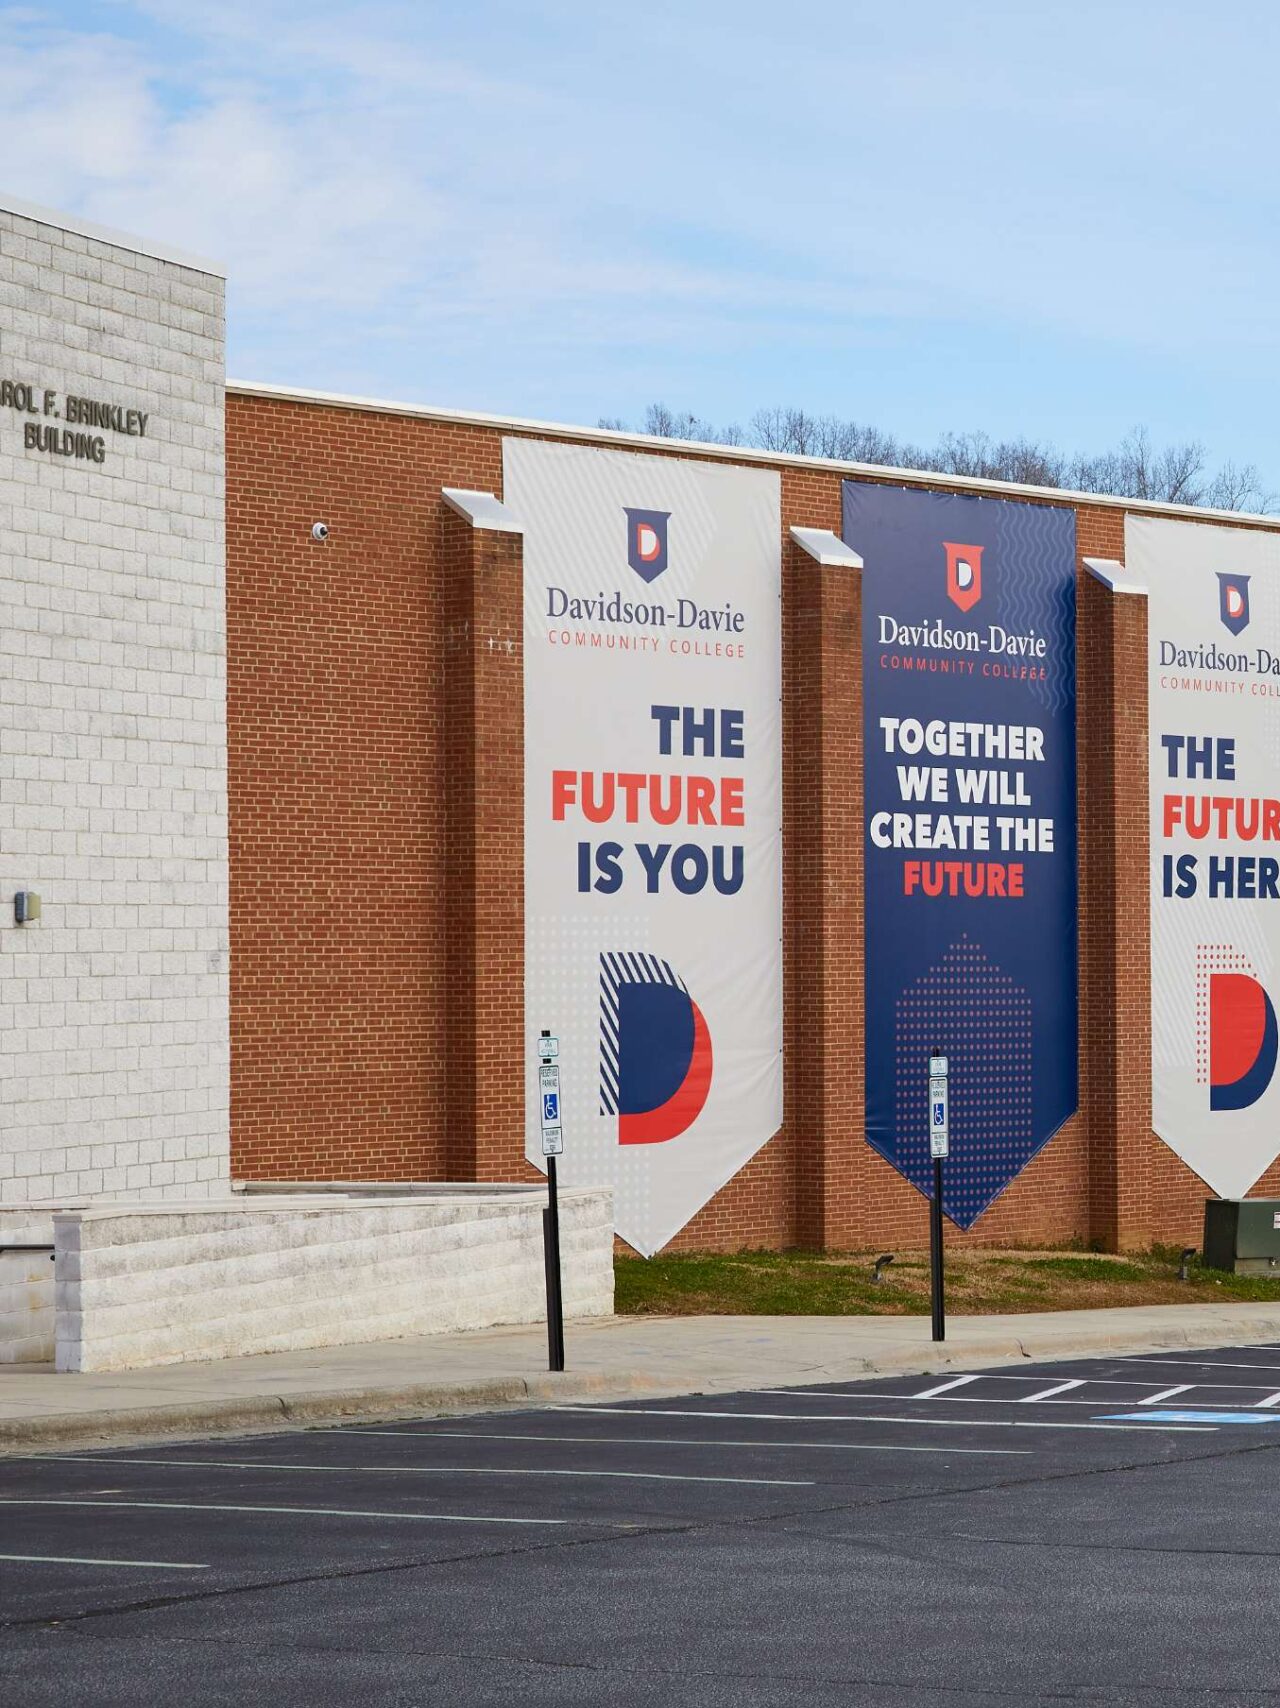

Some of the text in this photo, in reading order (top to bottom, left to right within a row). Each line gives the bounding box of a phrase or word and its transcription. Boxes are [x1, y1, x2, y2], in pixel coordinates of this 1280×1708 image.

[0, 380, 149, 436] ROL F. BRINKLEY
[25, 422, 105, 462] BUILDING
[546, 587, 744, 632] Davidson-Davie
[549, 629, 744, 658] COMMUNITY COLLEGE
[878, 616, 1046, 657] Davidson-Davie
[880, 655, 1046, 680] COMMUNITY COLLEGE
[1161, 677, 1244, 693] COMMUNITY
[651, 705, 744, 758] THE
[880, 717, 1045, 761] TOGETHER
[1161, 735, 1235, 781] THE
[552, 770, 744, 826] FUTURE
[896, 765, 1031, 806] WE WILL
[870, 812, 1054, 852] CREATE THE
[578, 842, 744, 895] IS YOU
[904, 861, 1023, 896] FUTURE
[1163, 854, 1198, 899] IS
